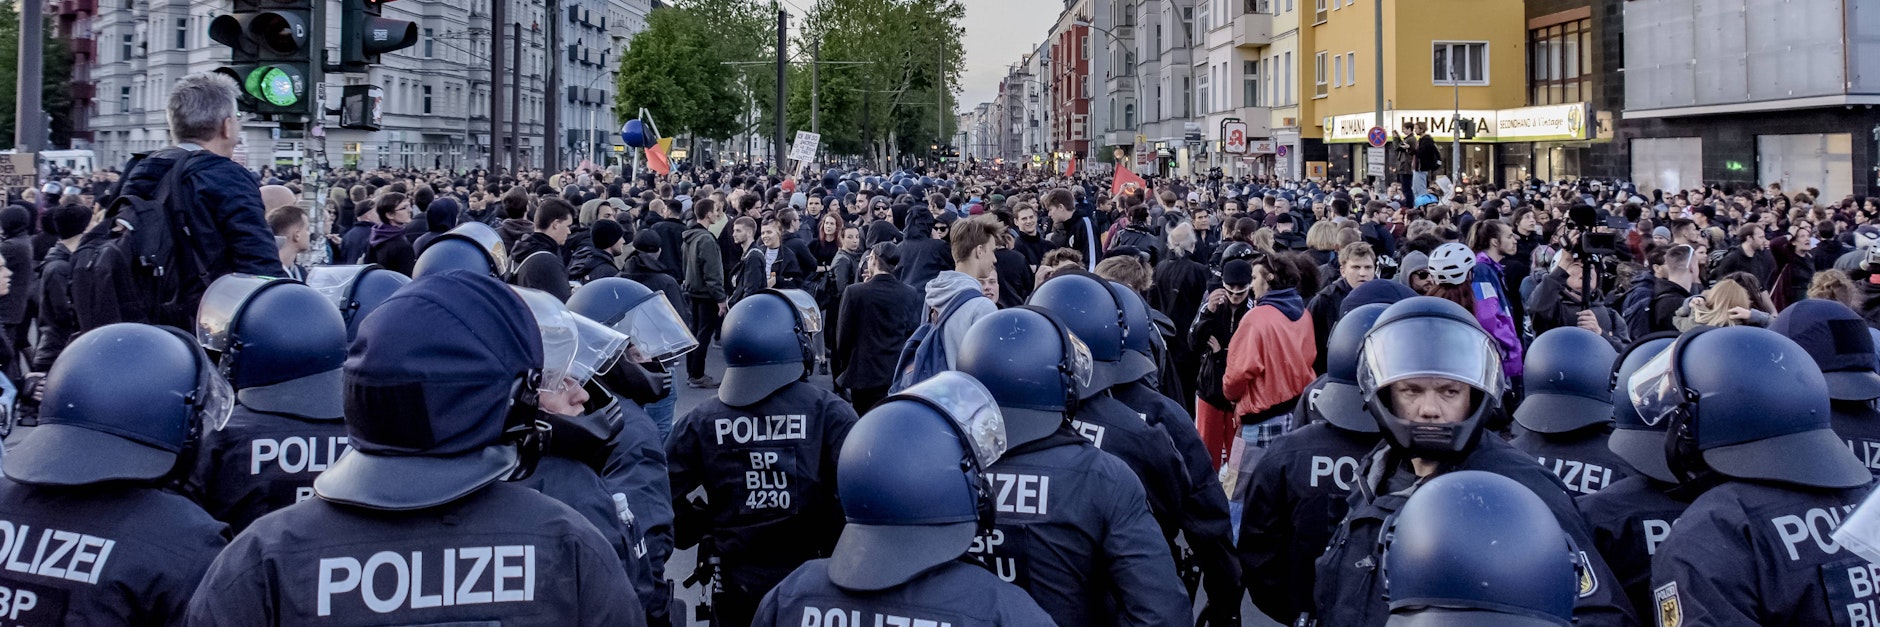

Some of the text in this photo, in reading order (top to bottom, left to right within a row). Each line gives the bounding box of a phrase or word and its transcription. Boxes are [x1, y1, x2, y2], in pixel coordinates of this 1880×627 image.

[1340, 119, 1366, 136] HUMANA
[1499, 119, 1531, 130] SECONDHAND
[715, 414, 807, 445] POLIZEI
[749, 452, 779, 470] BP
[745, 471, 788, 490] BLU
[745, 490, 791, 509] 4230
[317, 545, 536, 617] POLIZEI
